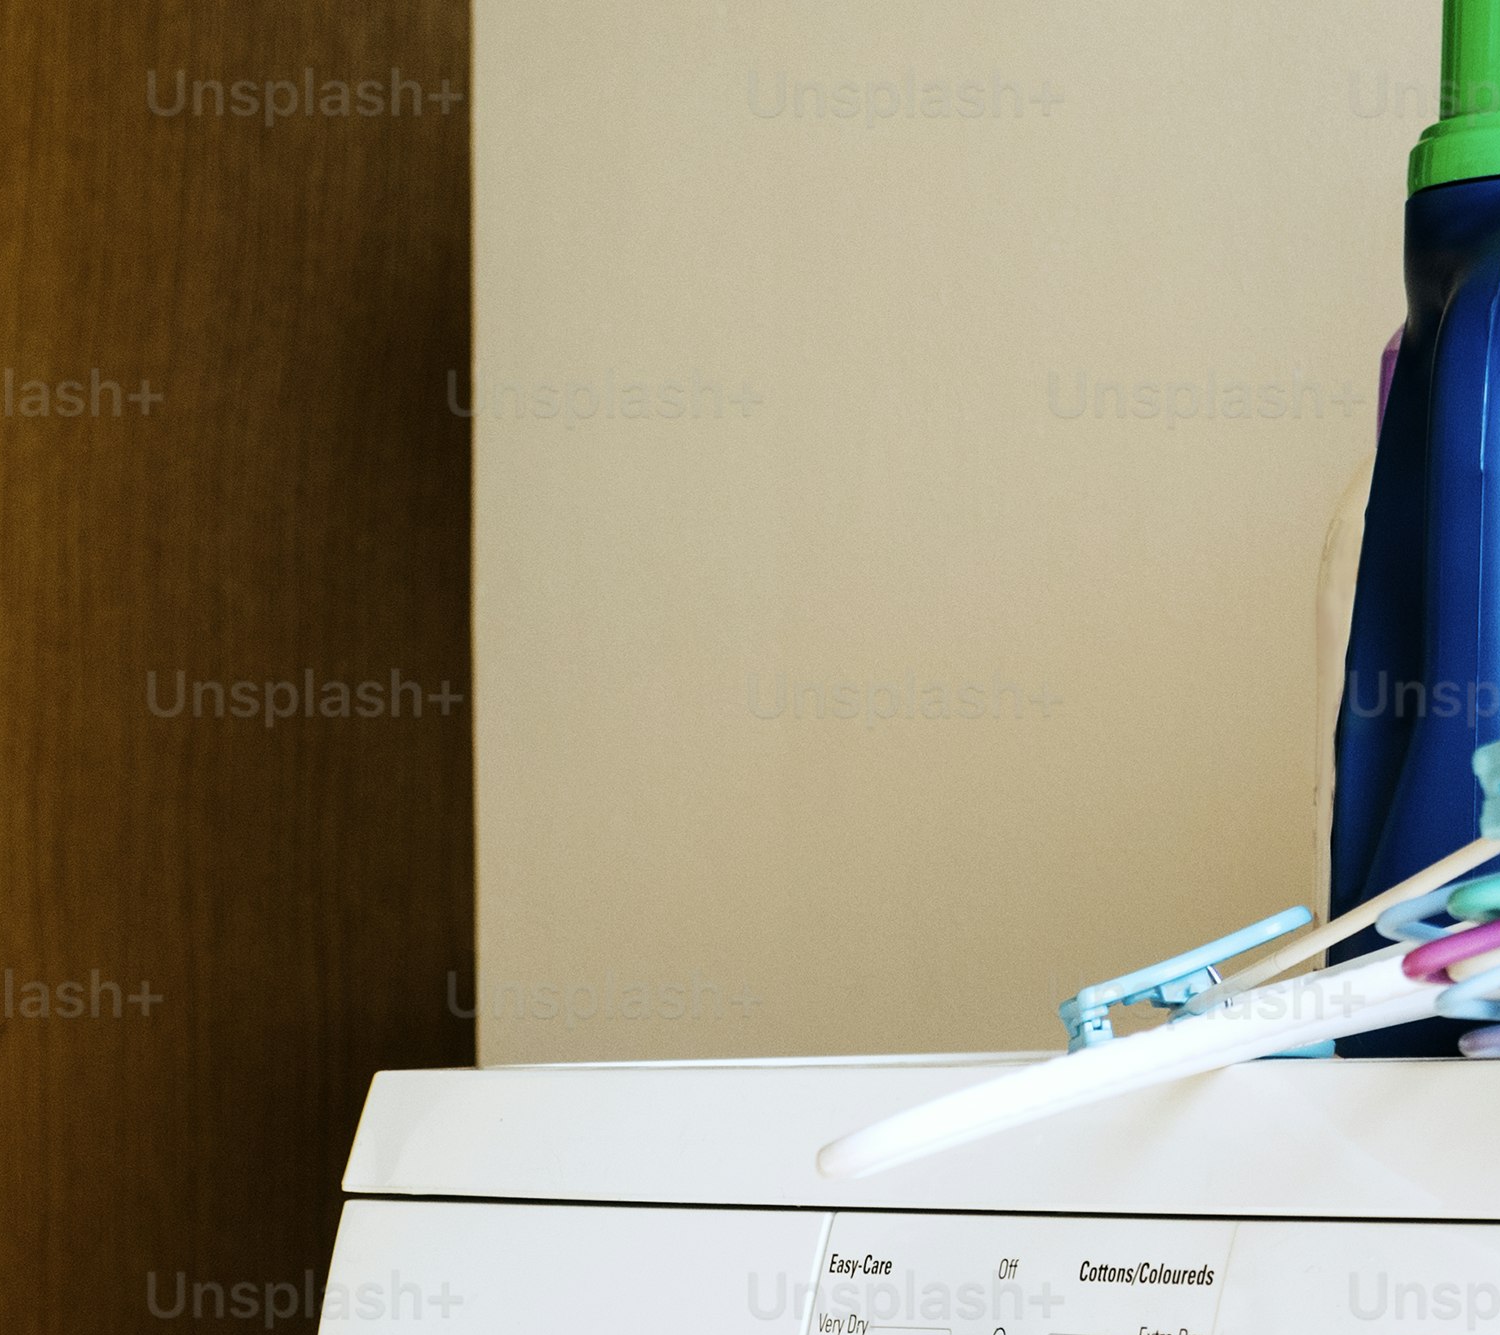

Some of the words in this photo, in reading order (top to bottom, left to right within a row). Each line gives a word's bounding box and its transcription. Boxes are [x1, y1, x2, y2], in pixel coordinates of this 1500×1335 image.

[828, 1253, 893, 1279] Easy-Care
[998, 1258, 1020, 1280] Off
[1078, 1260, 1215, 1286] Cottons/Coloureds
